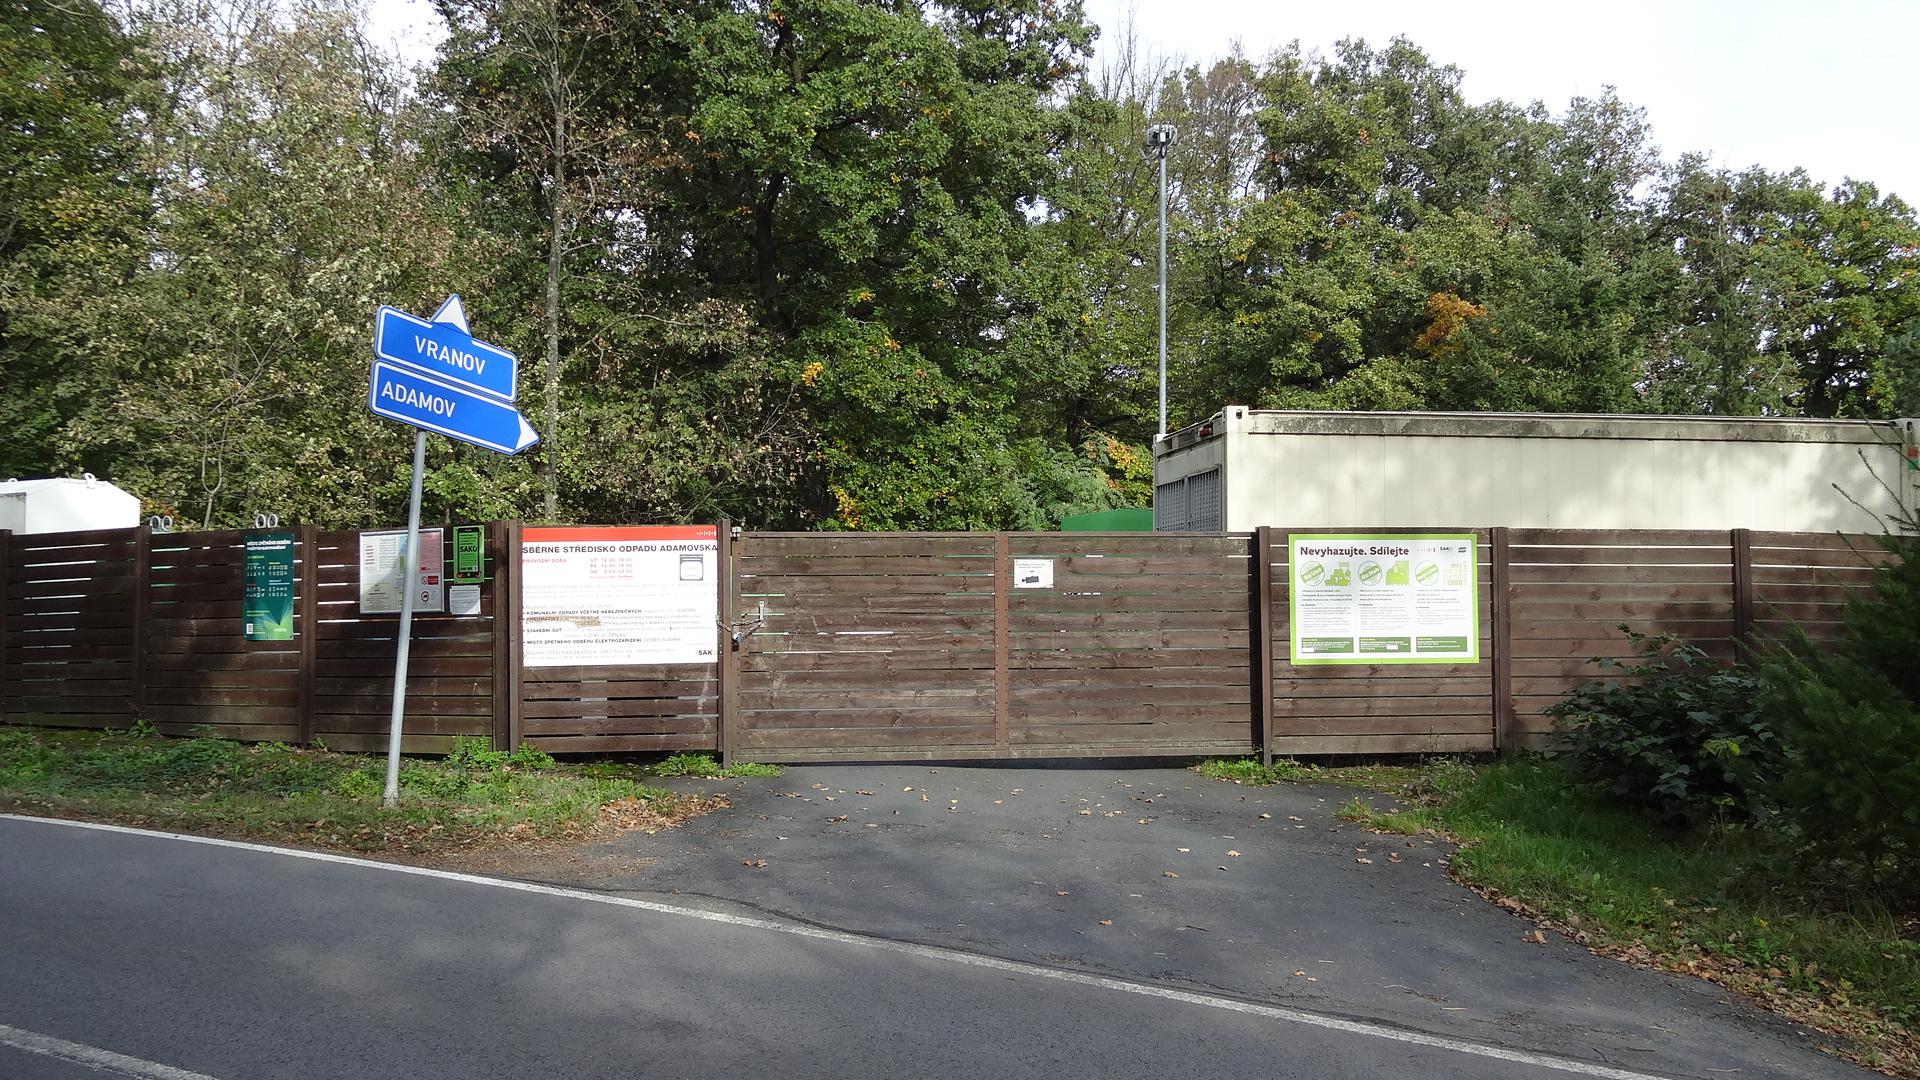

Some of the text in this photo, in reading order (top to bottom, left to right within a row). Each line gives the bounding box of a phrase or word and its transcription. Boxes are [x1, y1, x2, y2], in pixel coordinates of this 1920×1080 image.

[414, 335, 486, 375] VRANOV
[381, 381, 456, 418] ADAMOV
[563, 544, 616, 553] STŘEDISKO
[1300, 546, 1410, 558] Nevyhazujte. Sdílejte
